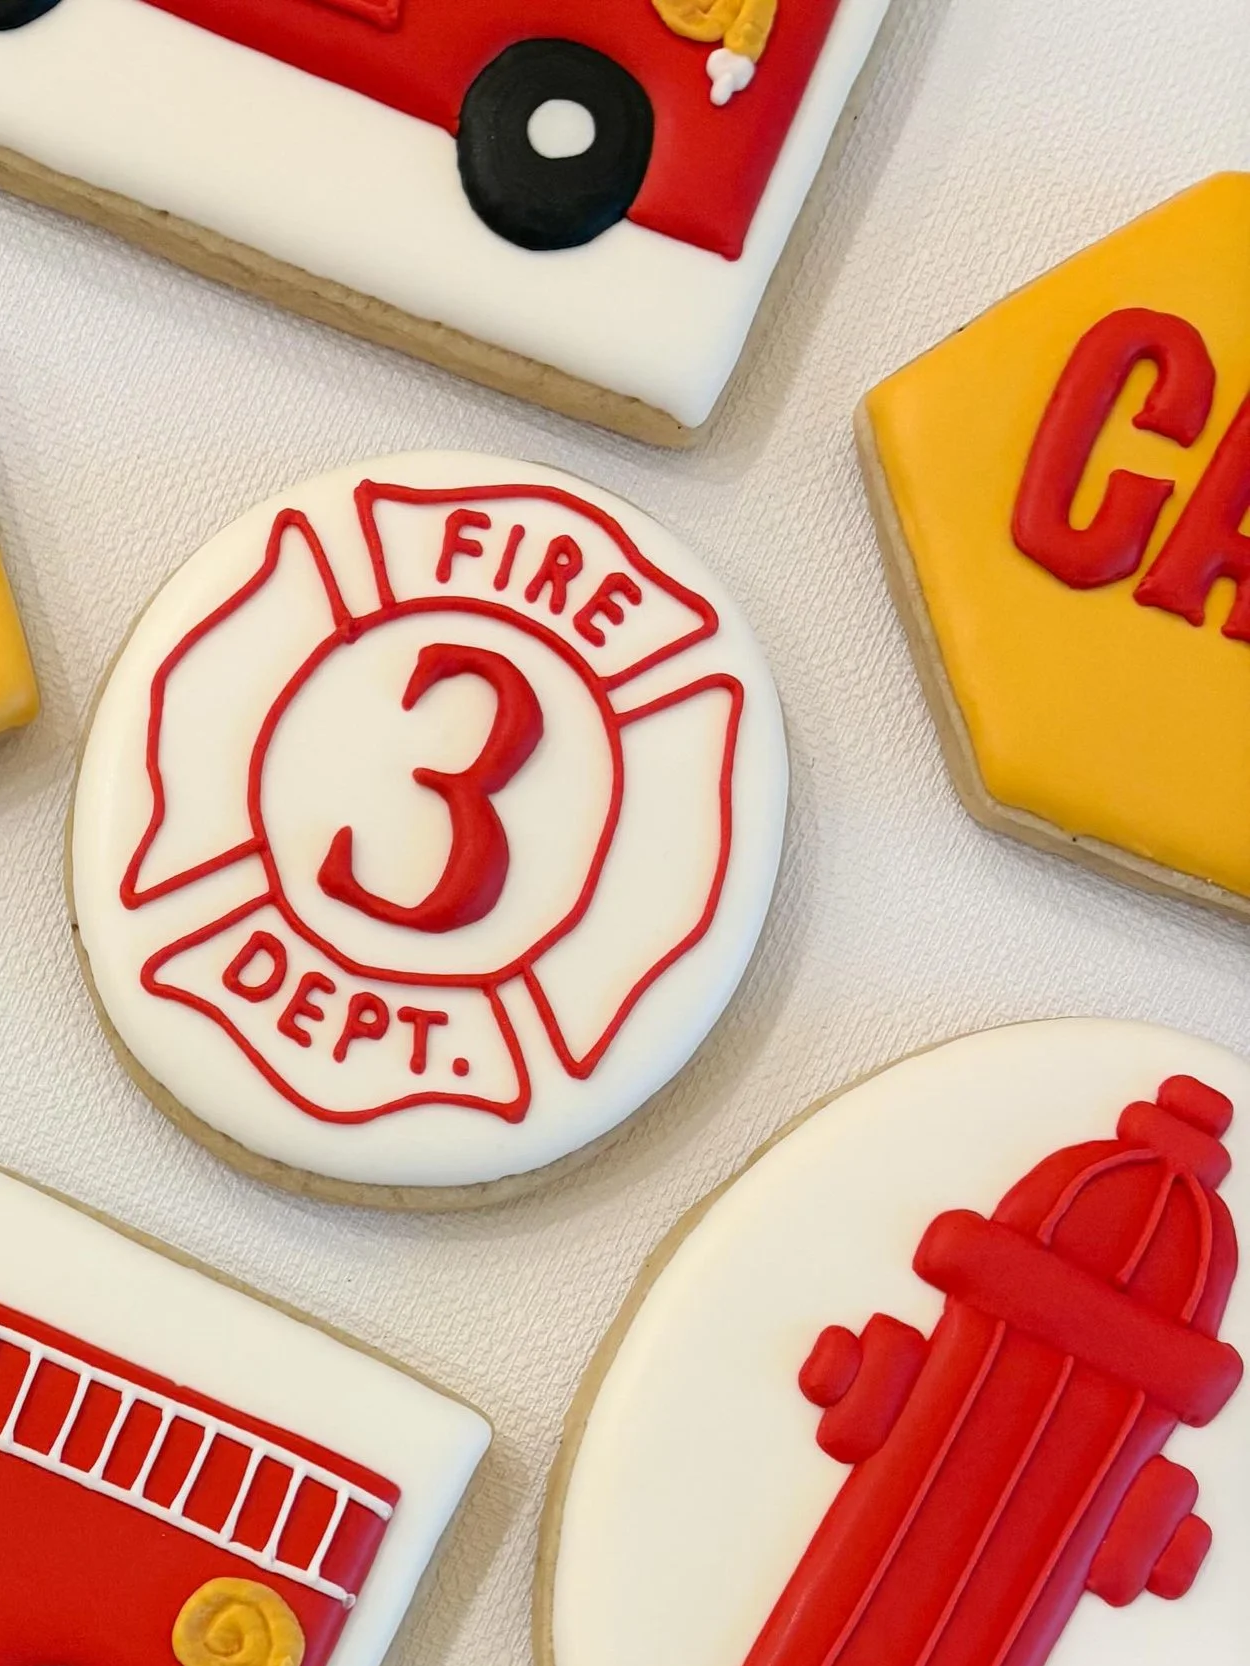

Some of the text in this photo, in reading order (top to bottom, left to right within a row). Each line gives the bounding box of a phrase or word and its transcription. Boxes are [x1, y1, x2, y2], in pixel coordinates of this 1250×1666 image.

[435, 508, 642, 647] FIRE
[317, 643, 544, 934] 3
[222, 930, 469, 1076] DEPT.
